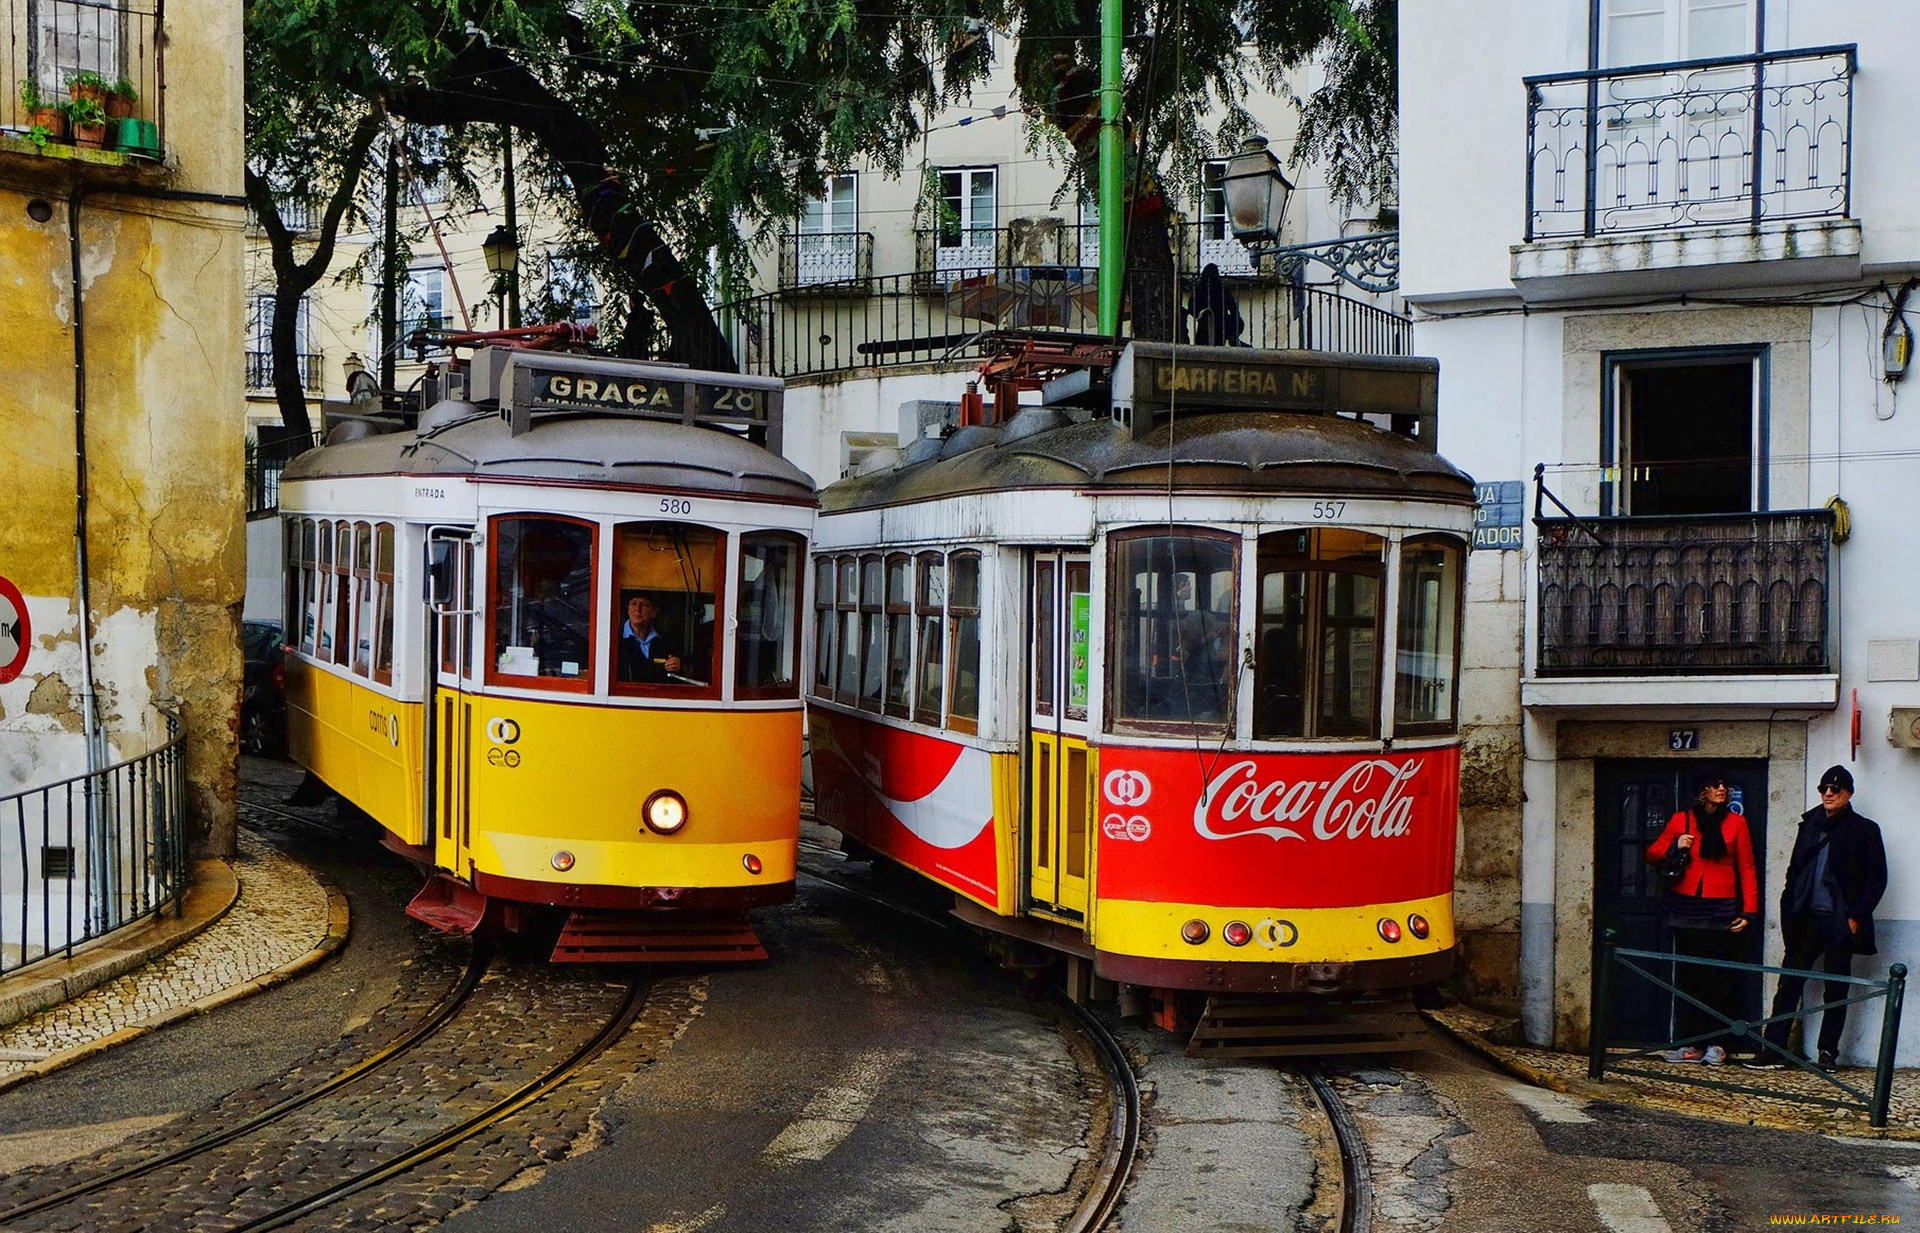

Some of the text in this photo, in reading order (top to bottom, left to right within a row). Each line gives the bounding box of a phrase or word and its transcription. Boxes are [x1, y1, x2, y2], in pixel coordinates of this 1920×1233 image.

[550, 375, 673, 408] GRAÇA
[713, 386, 755, 412] 28
[414, 487, 446, 499] ENTRADA
[659, 498, 691, 515] 580
[1312, 501, 1347, 519] 557
[1672, 730, 1694, 749] 37
[1193, 758, 1425, 842] Coca-Cola
